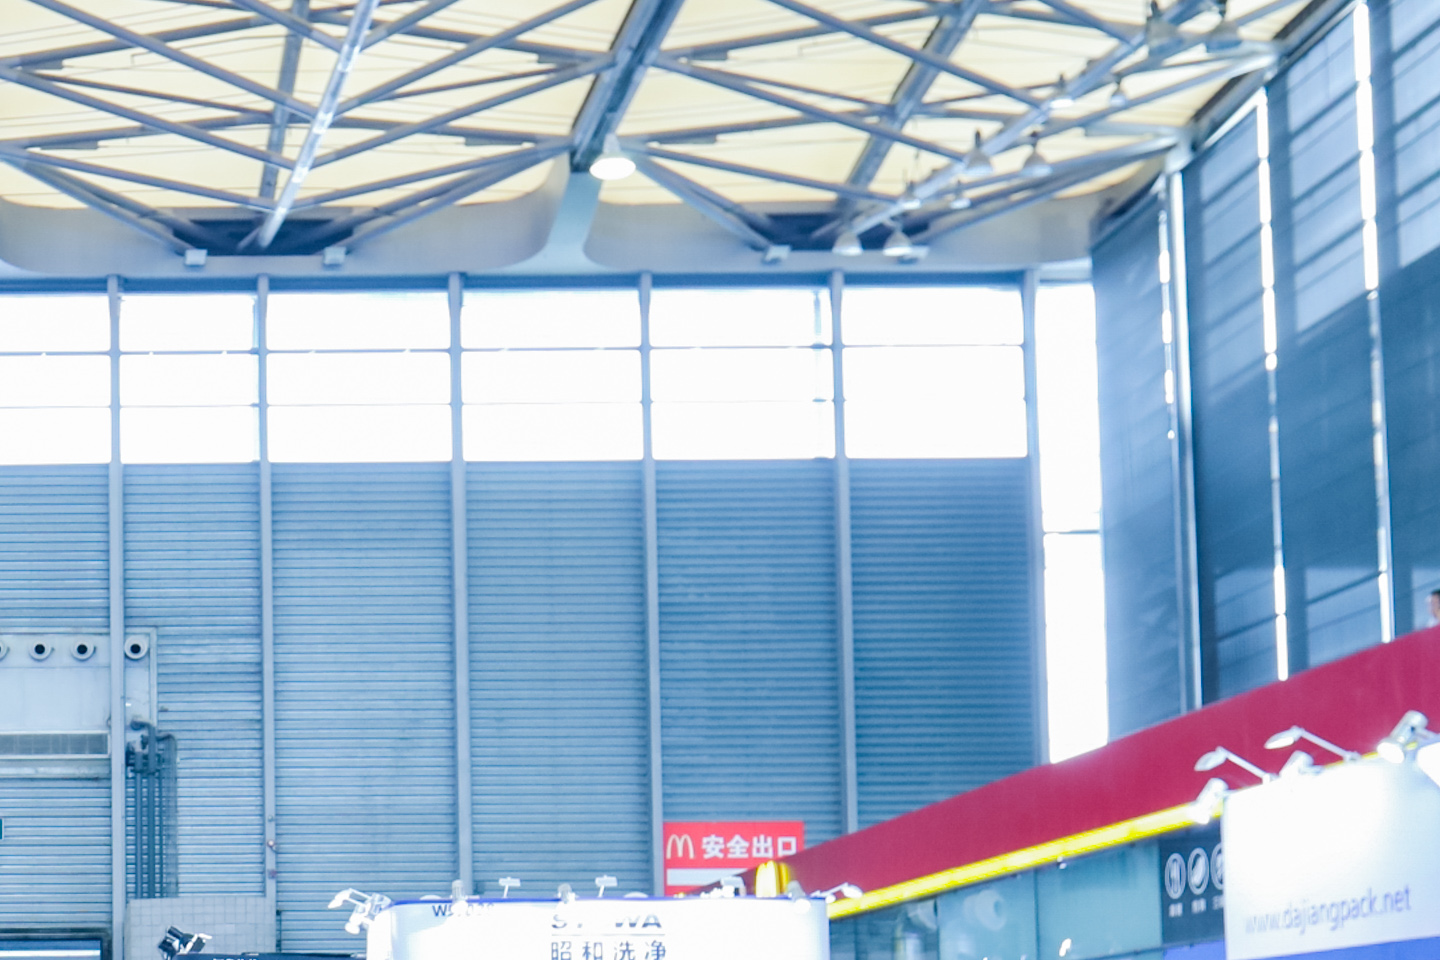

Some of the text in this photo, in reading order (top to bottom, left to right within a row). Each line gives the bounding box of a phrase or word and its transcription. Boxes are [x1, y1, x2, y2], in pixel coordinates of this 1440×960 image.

[702, 834, 797, 859] 安全出口
[1245, 884, 1412, 936] www.dajiangpack.net
